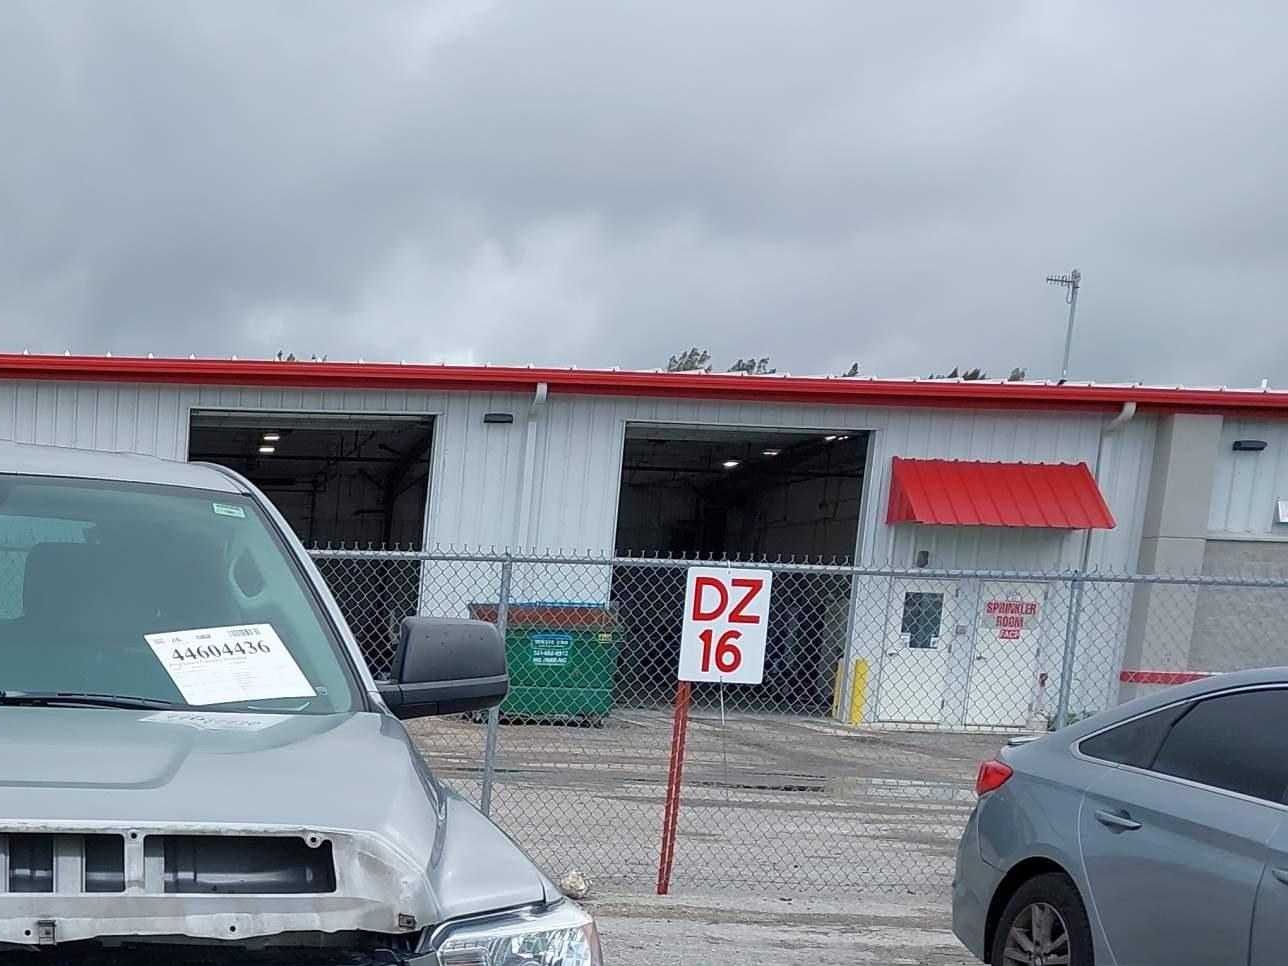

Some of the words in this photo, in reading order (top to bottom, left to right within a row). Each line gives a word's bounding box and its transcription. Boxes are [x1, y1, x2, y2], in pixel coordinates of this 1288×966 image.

[692, 577, 764, 624] DZ
[987, 602, 1037, 615] SPRINKLER
[996, 616, 1024, 627] ROOM
[172, 640, 271, 661] 44604436
[699, 629, 742, 673] 16
